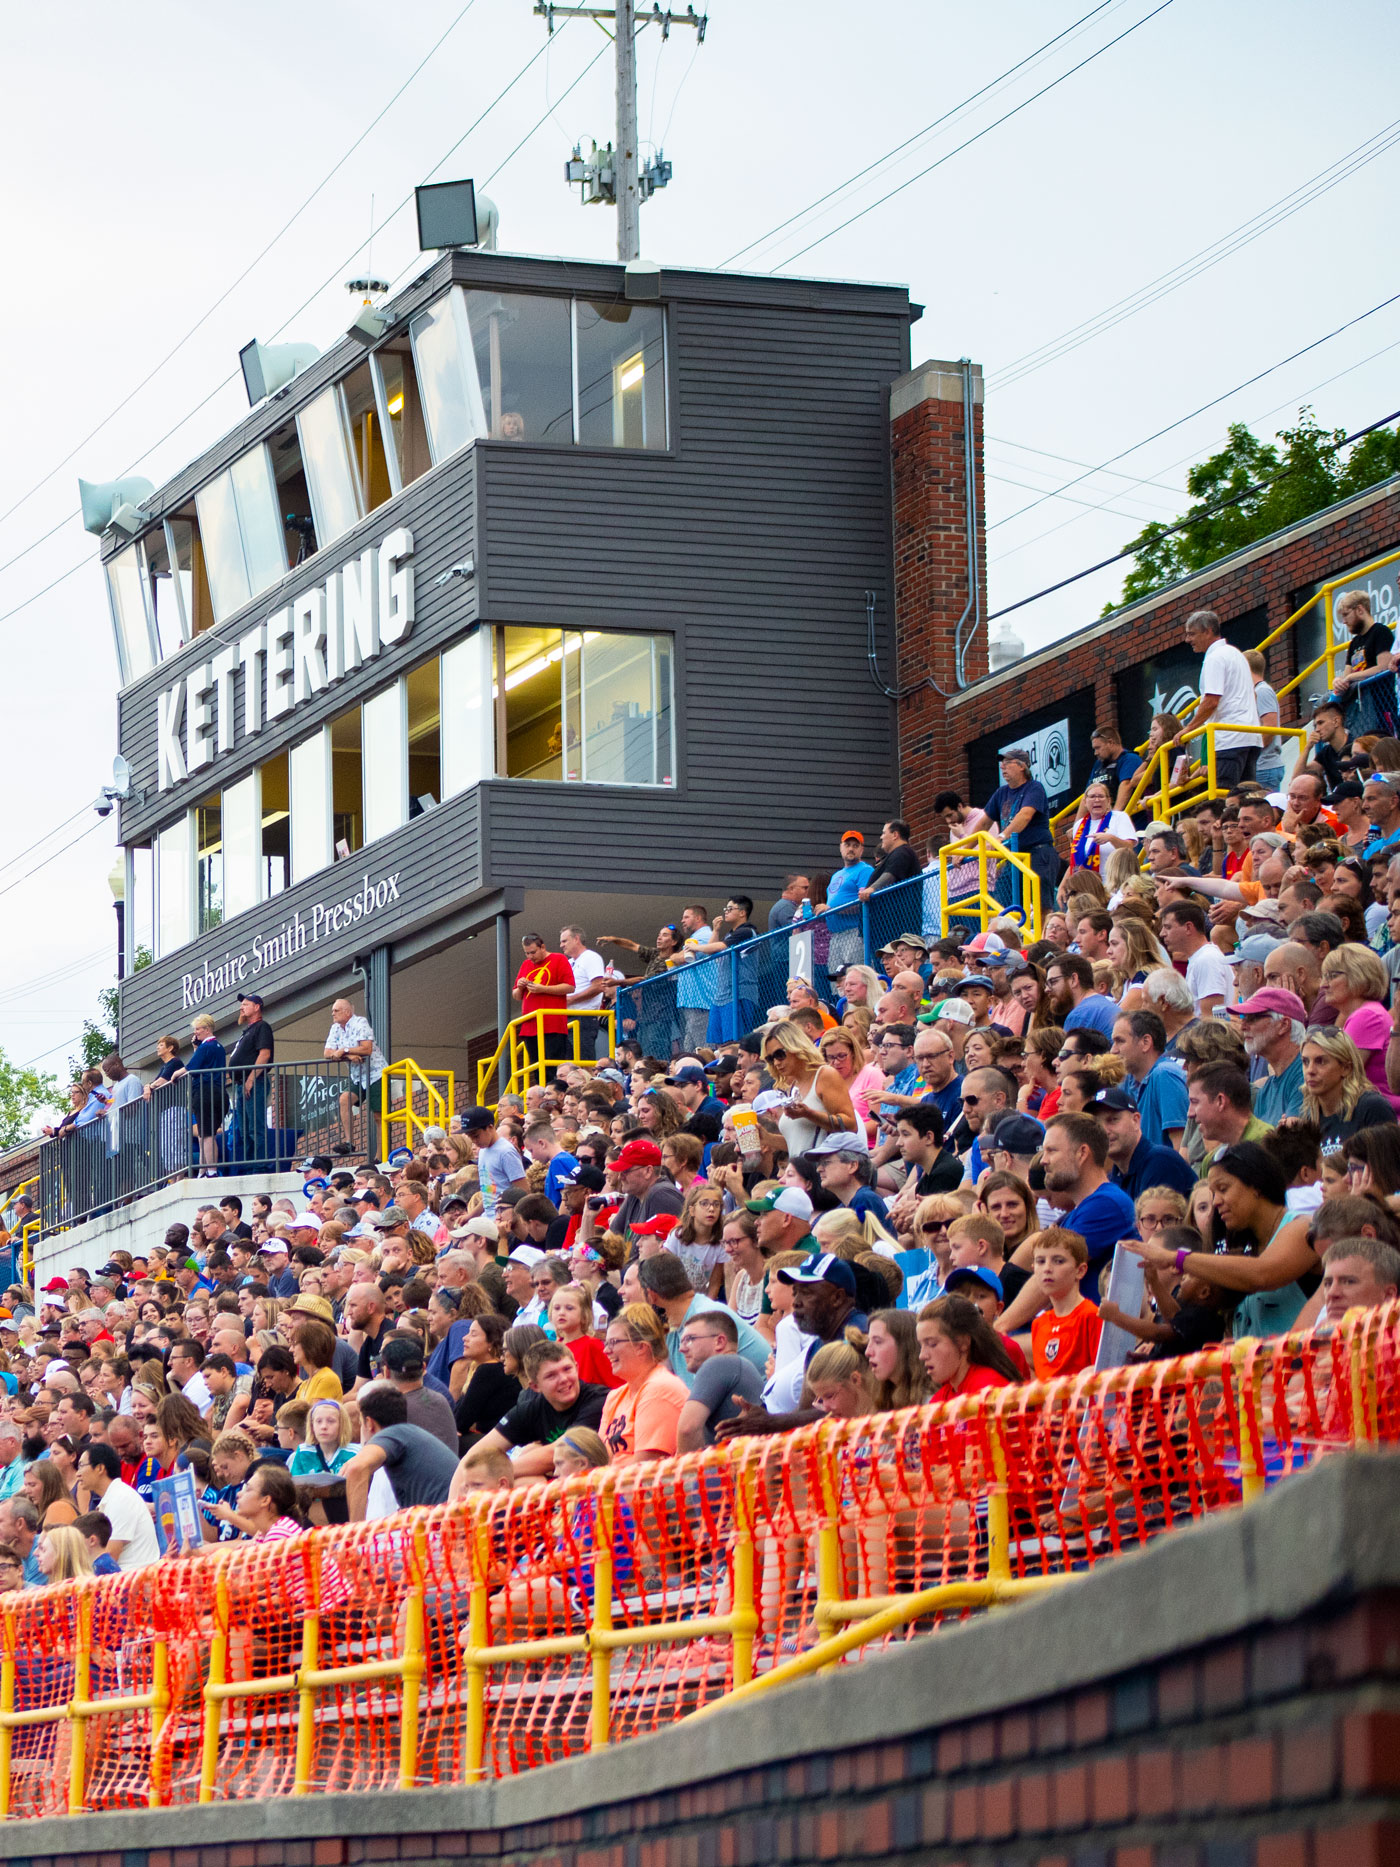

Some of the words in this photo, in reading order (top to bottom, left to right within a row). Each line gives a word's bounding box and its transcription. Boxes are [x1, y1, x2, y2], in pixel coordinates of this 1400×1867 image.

[157, 527, 416, 793] KETTERING
[181, 953, 248, 1010] Robaire
[252, 911, 308, 974] Smith
[311, 872, 401, 943] Pressbox
[795, 940, 806, 978] 2
